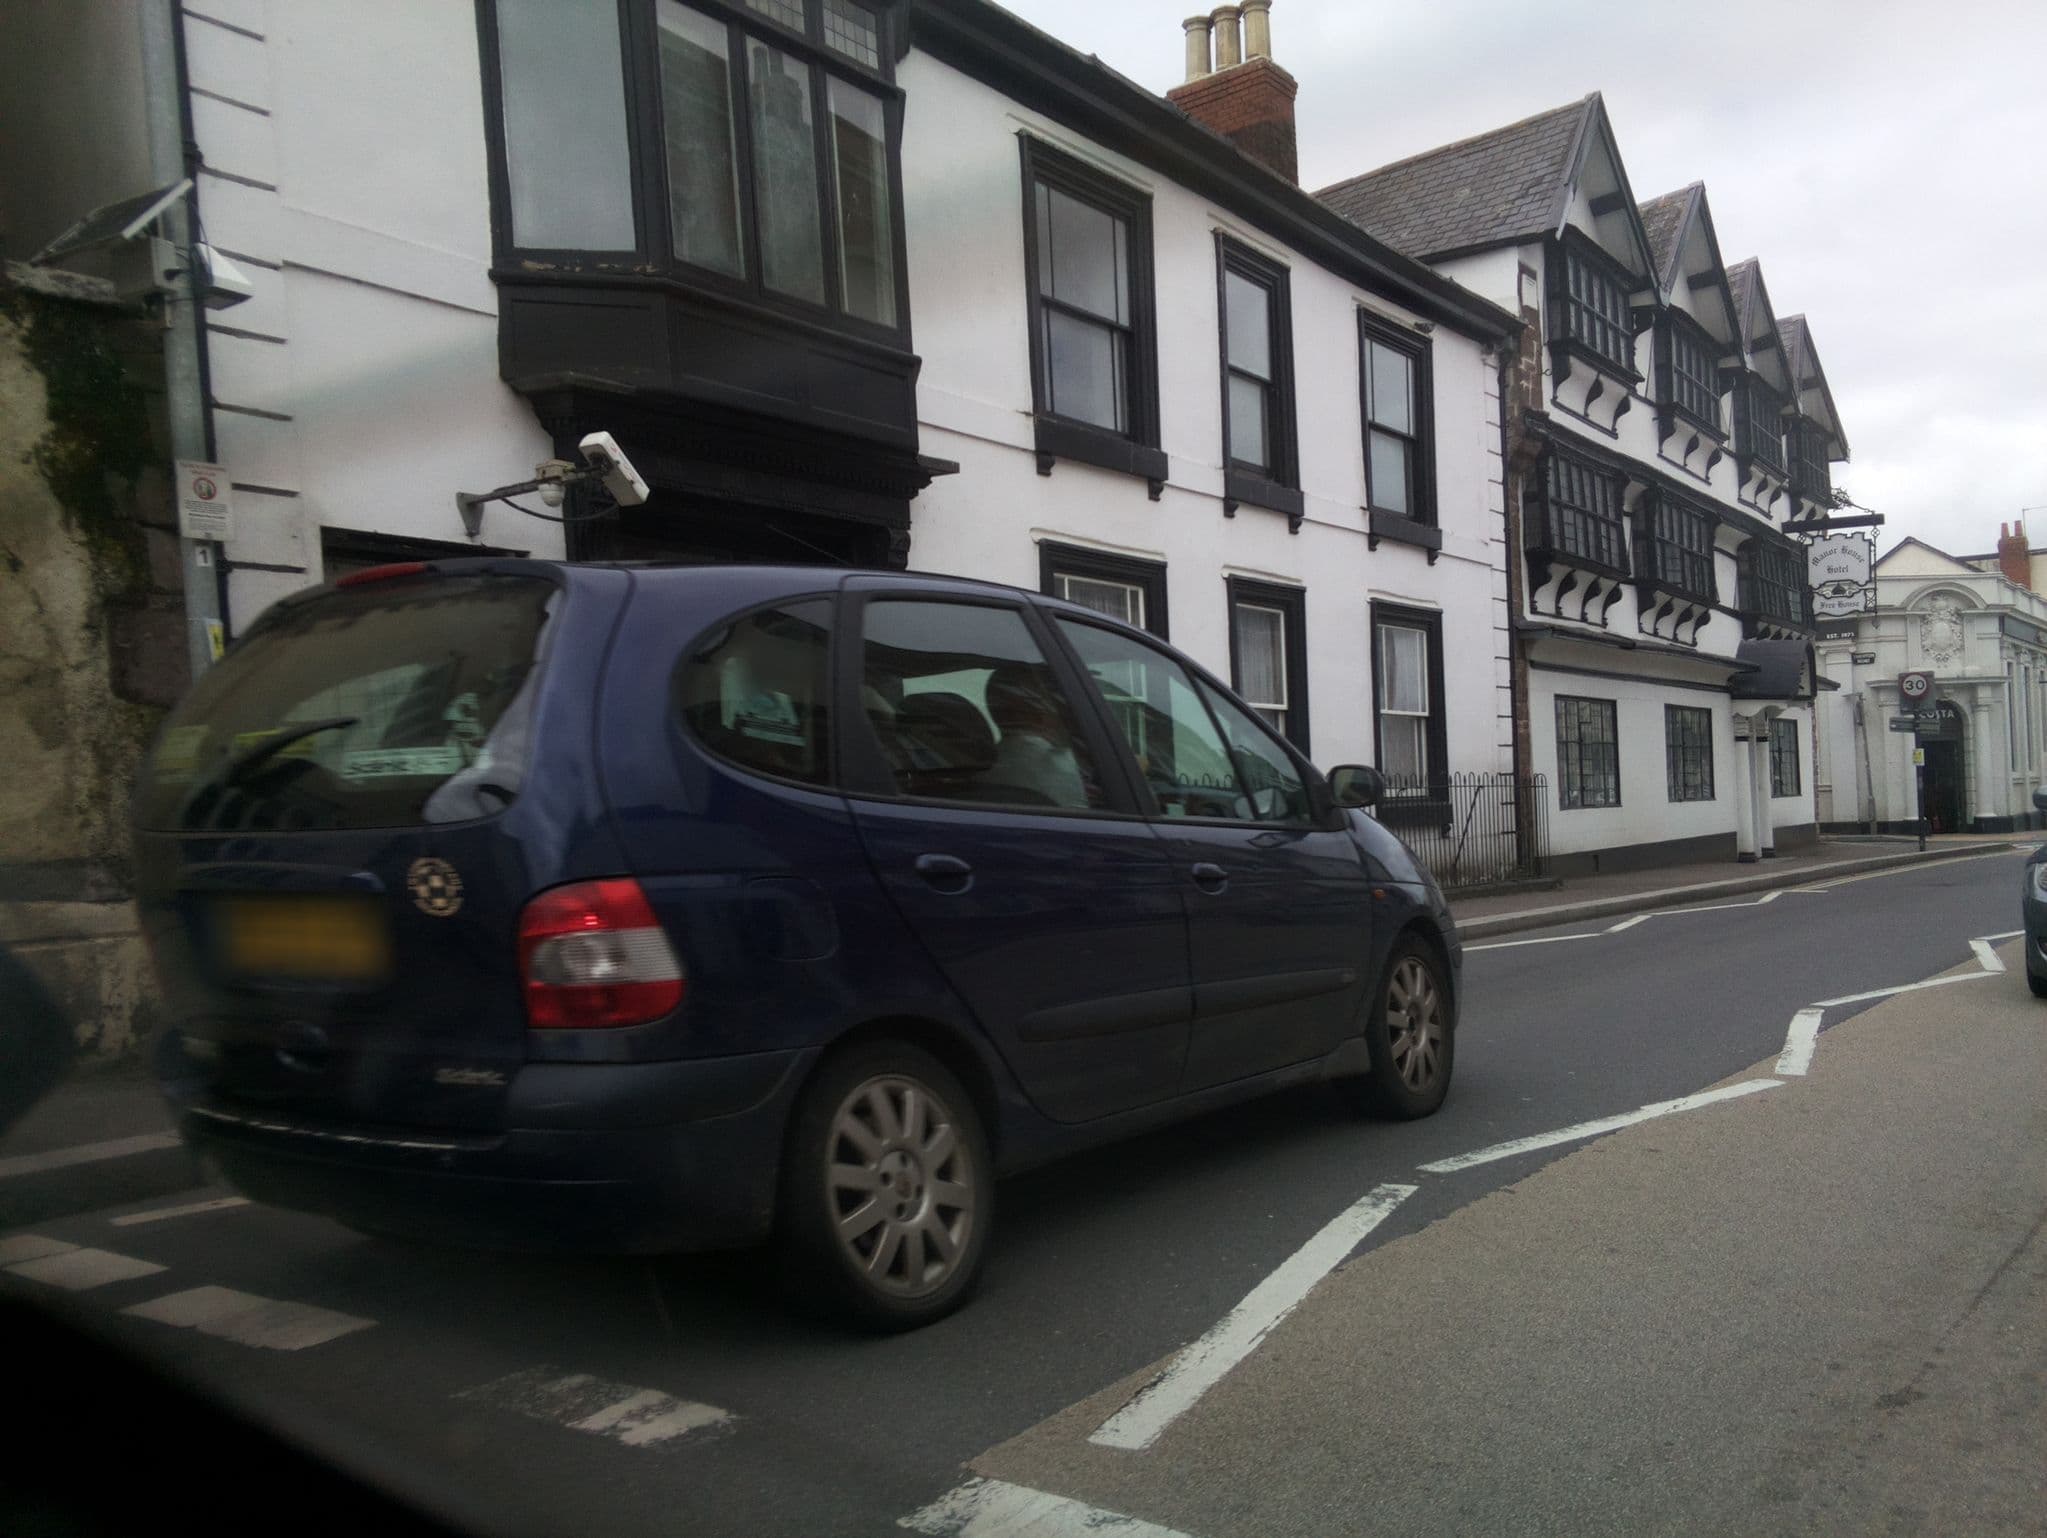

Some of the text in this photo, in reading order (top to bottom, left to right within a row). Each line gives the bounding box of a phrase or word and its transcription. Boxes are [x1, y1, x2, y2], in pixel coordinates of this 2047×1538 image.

[199, 549, 209, 565] 1
[1811, 545, 1865, 566] Manor House
[1826, 565, 1849, 574] Hotel
[1820, 600, 1859, 609] Free House
[1905, 680, 1925, 691] 30
[1919, 709, 1955, 719] COSTA
